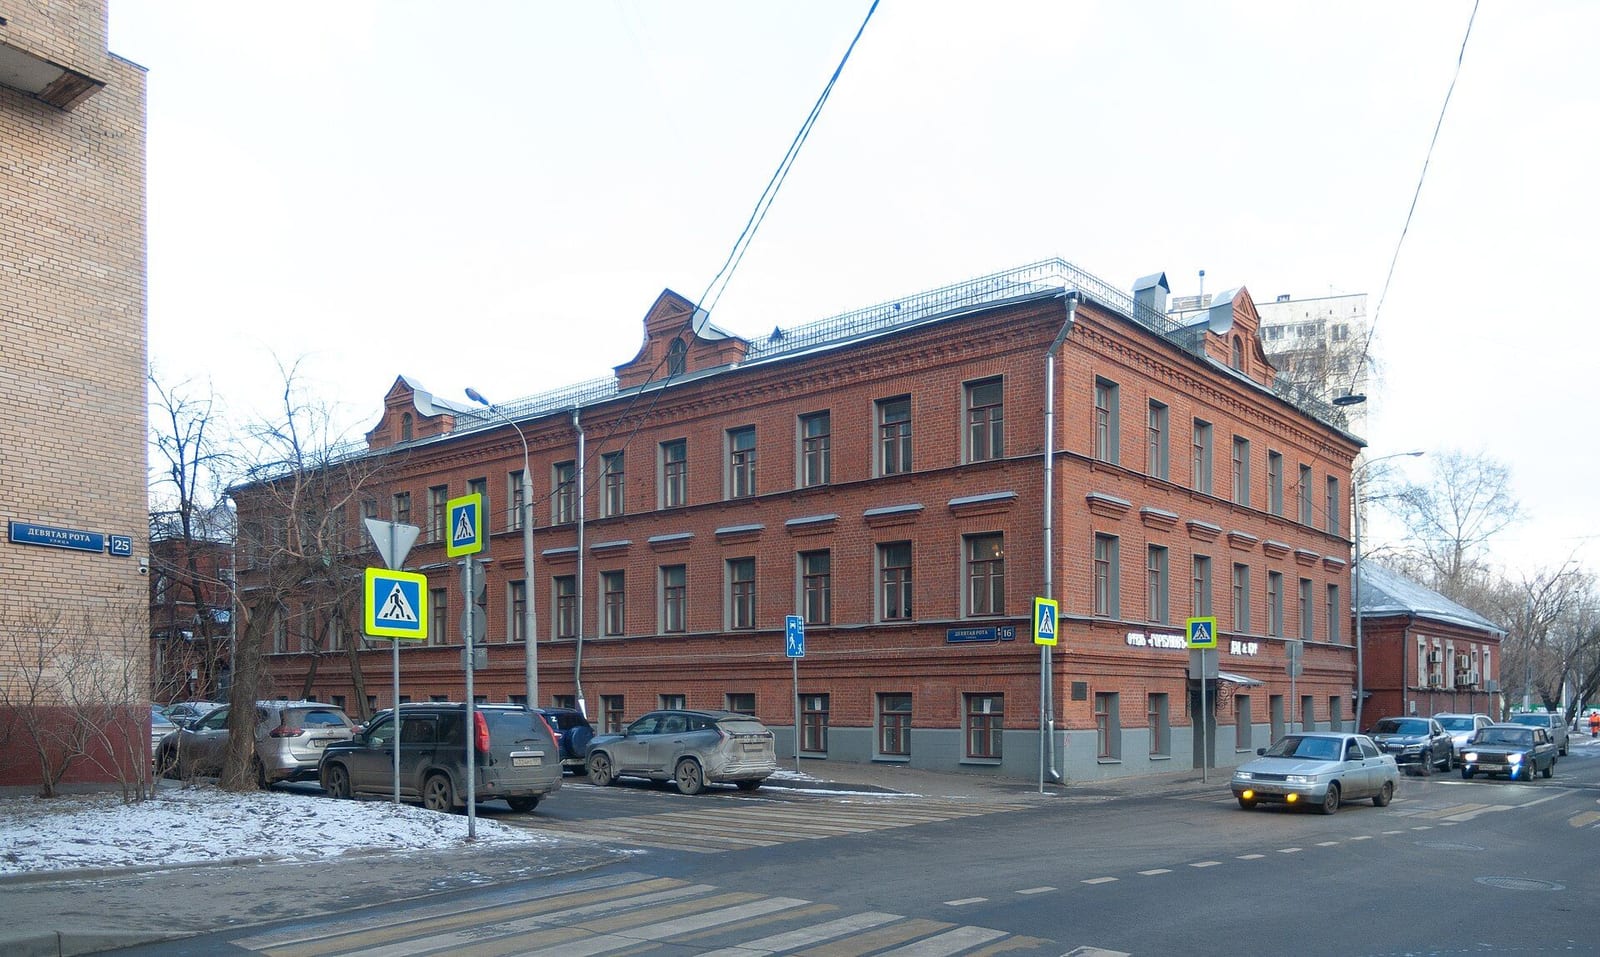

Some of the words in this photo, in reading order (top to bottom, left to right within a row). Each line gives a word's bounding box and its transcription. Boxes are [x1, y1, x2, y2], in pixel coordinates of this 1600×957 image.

[27, 527, 67, 538] ДЕВЯТАЯ
[69, 533, 91, 543] РОТА
[114, 539, 129, 551] 25
[1003, 629, 1012, 638] 16
